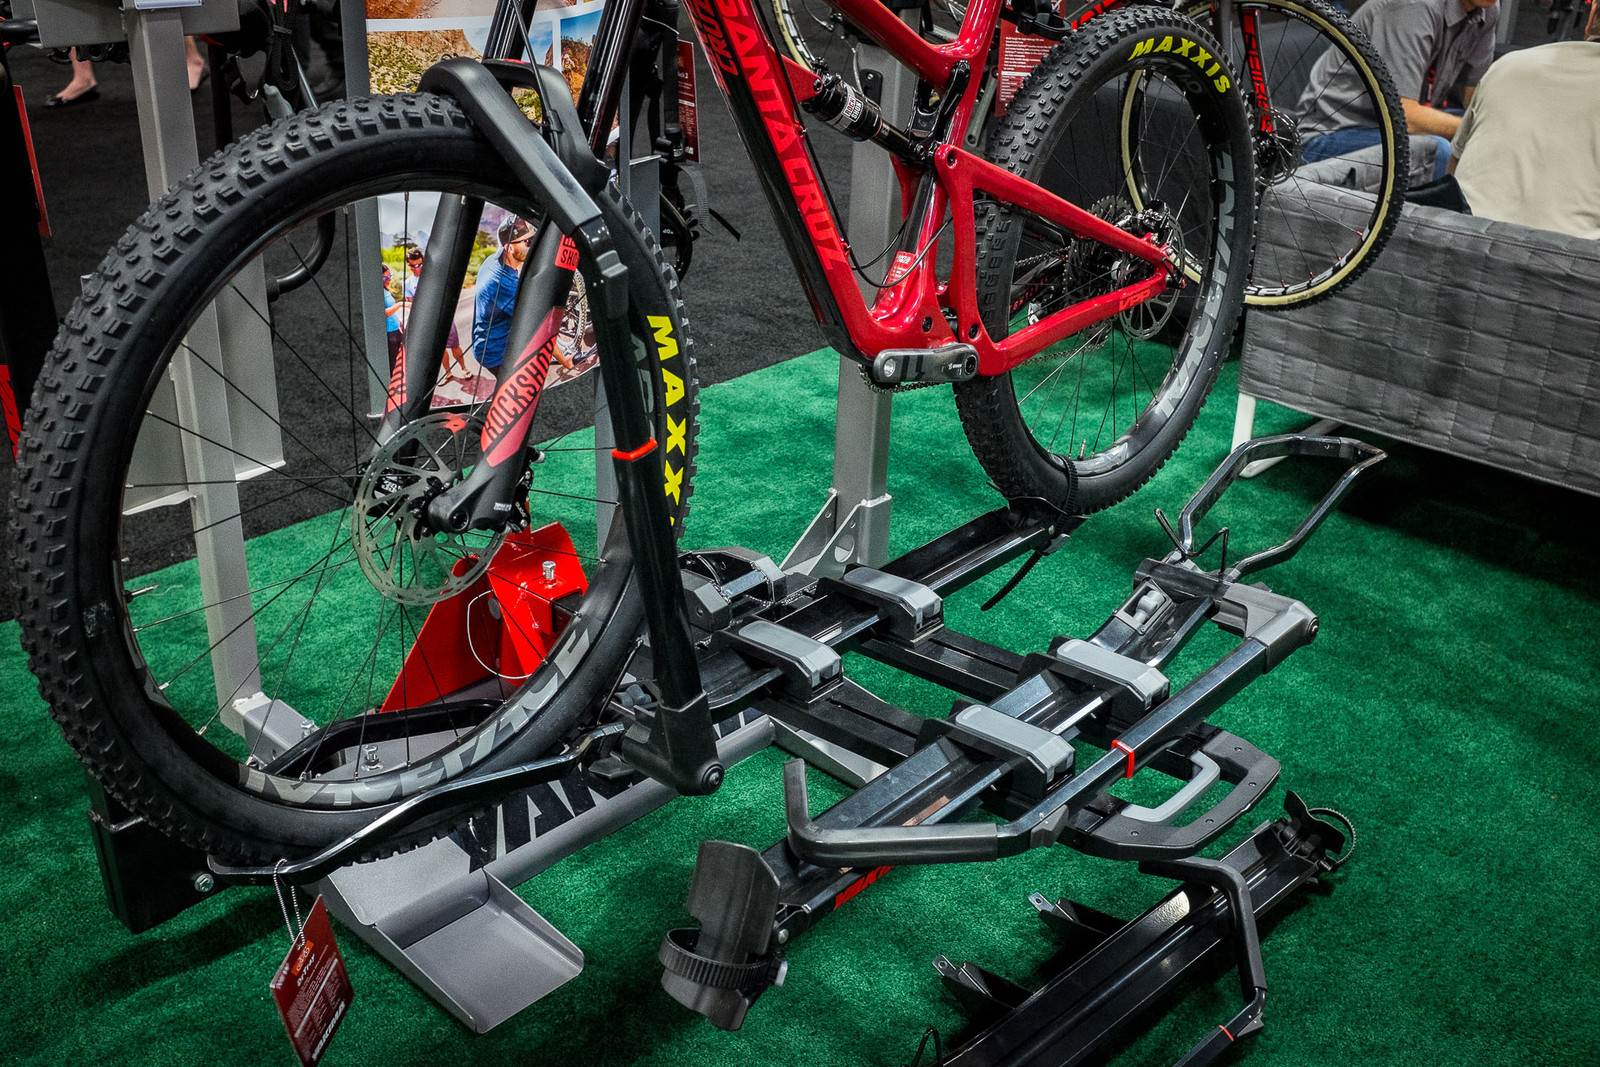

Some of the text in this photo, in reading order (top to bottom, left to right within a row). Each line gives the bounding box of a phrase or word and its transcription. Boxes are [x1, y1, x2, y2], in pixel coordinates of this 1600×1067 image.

[1128, 35, 1230, 93] MAXXIS
[716, 0, 798, 153] SANTA
[783, 157, 847, 270] CRUZ
[844, 98, 855, 116] ROCK
[1119, 288, 1150, 312] VPP
[646, 315, 686, 527] MAXX
[311, 1000, 346, 1062] YAKIMA
